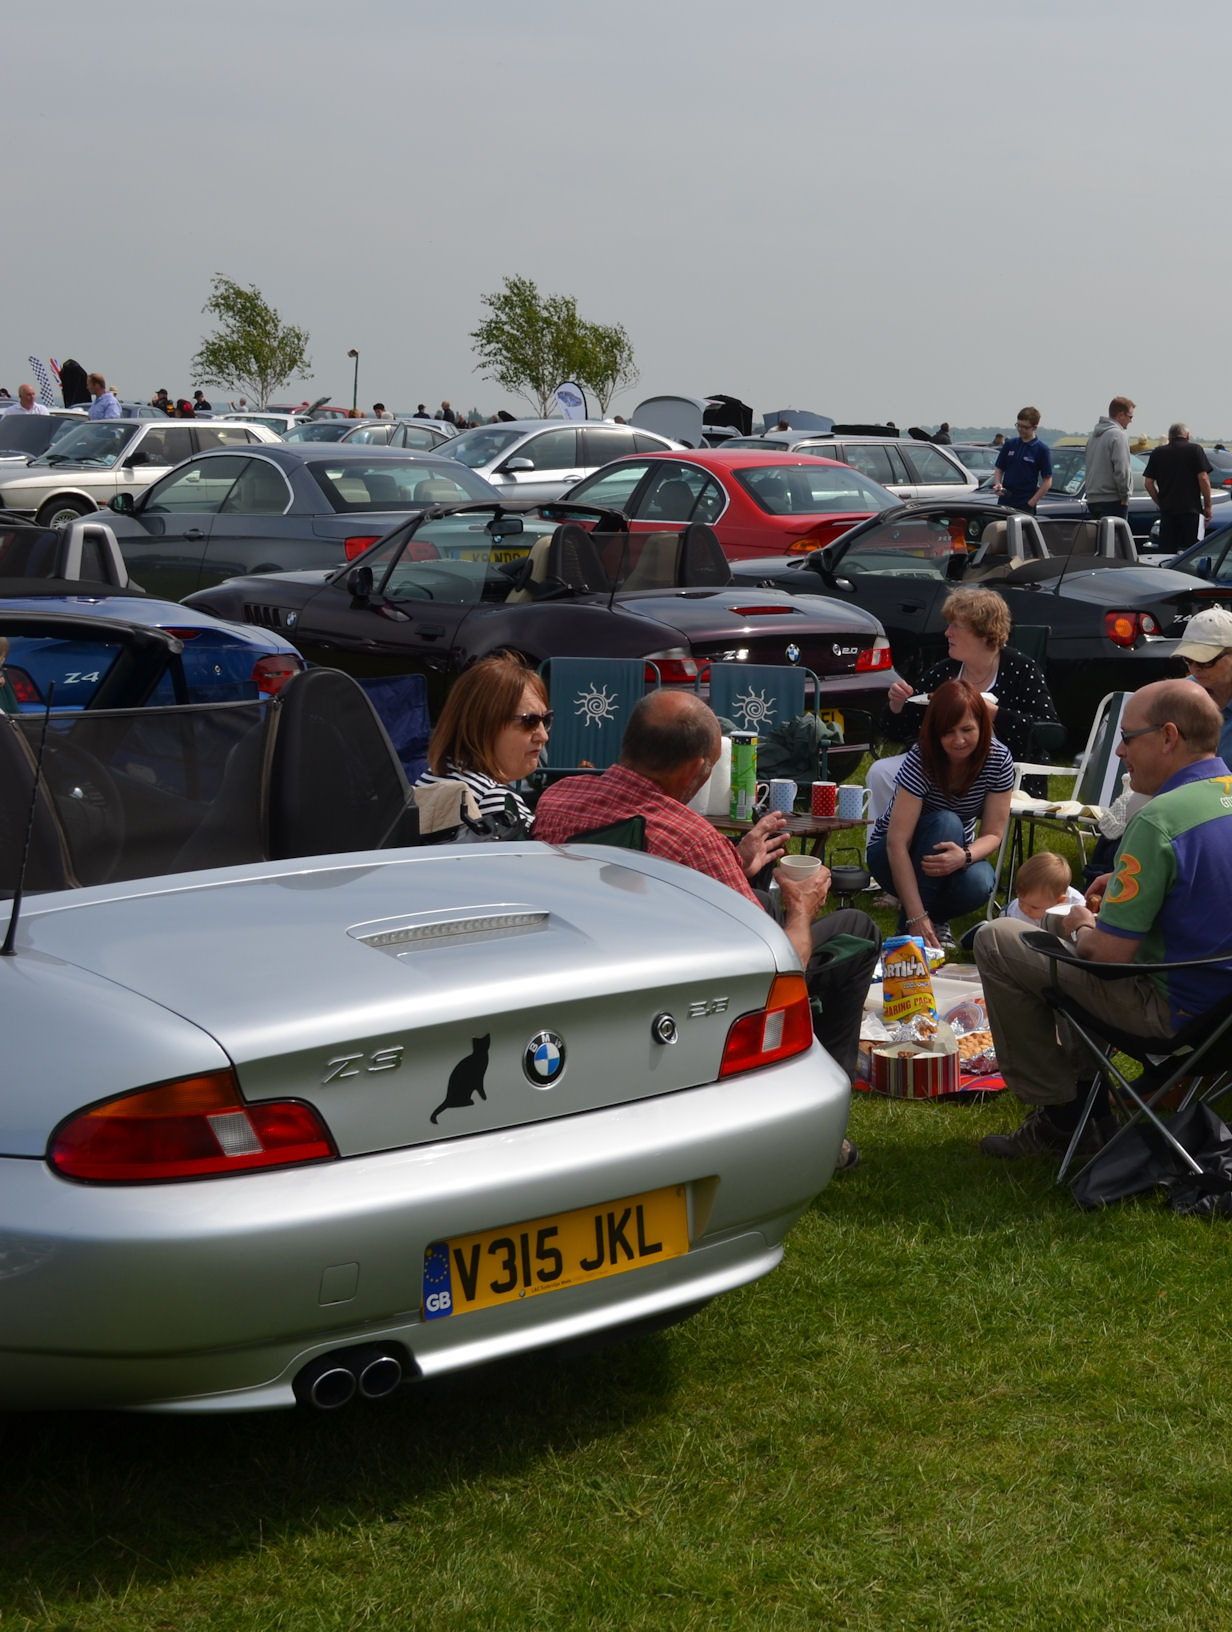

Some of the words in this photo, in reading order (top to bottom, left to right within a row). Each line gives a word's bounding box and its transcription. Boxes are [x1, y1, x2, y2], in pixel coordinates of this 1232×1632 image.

[63, 671, 99, 684] Z4
[1106, 854, 1142, 903] 3
[322, 1045, 405, 1085] Z3
[453, 1226, 563, 1302] V315
[580, 1204, 663, 1272] JKL
[426, 1291, 451, 1312] GB
